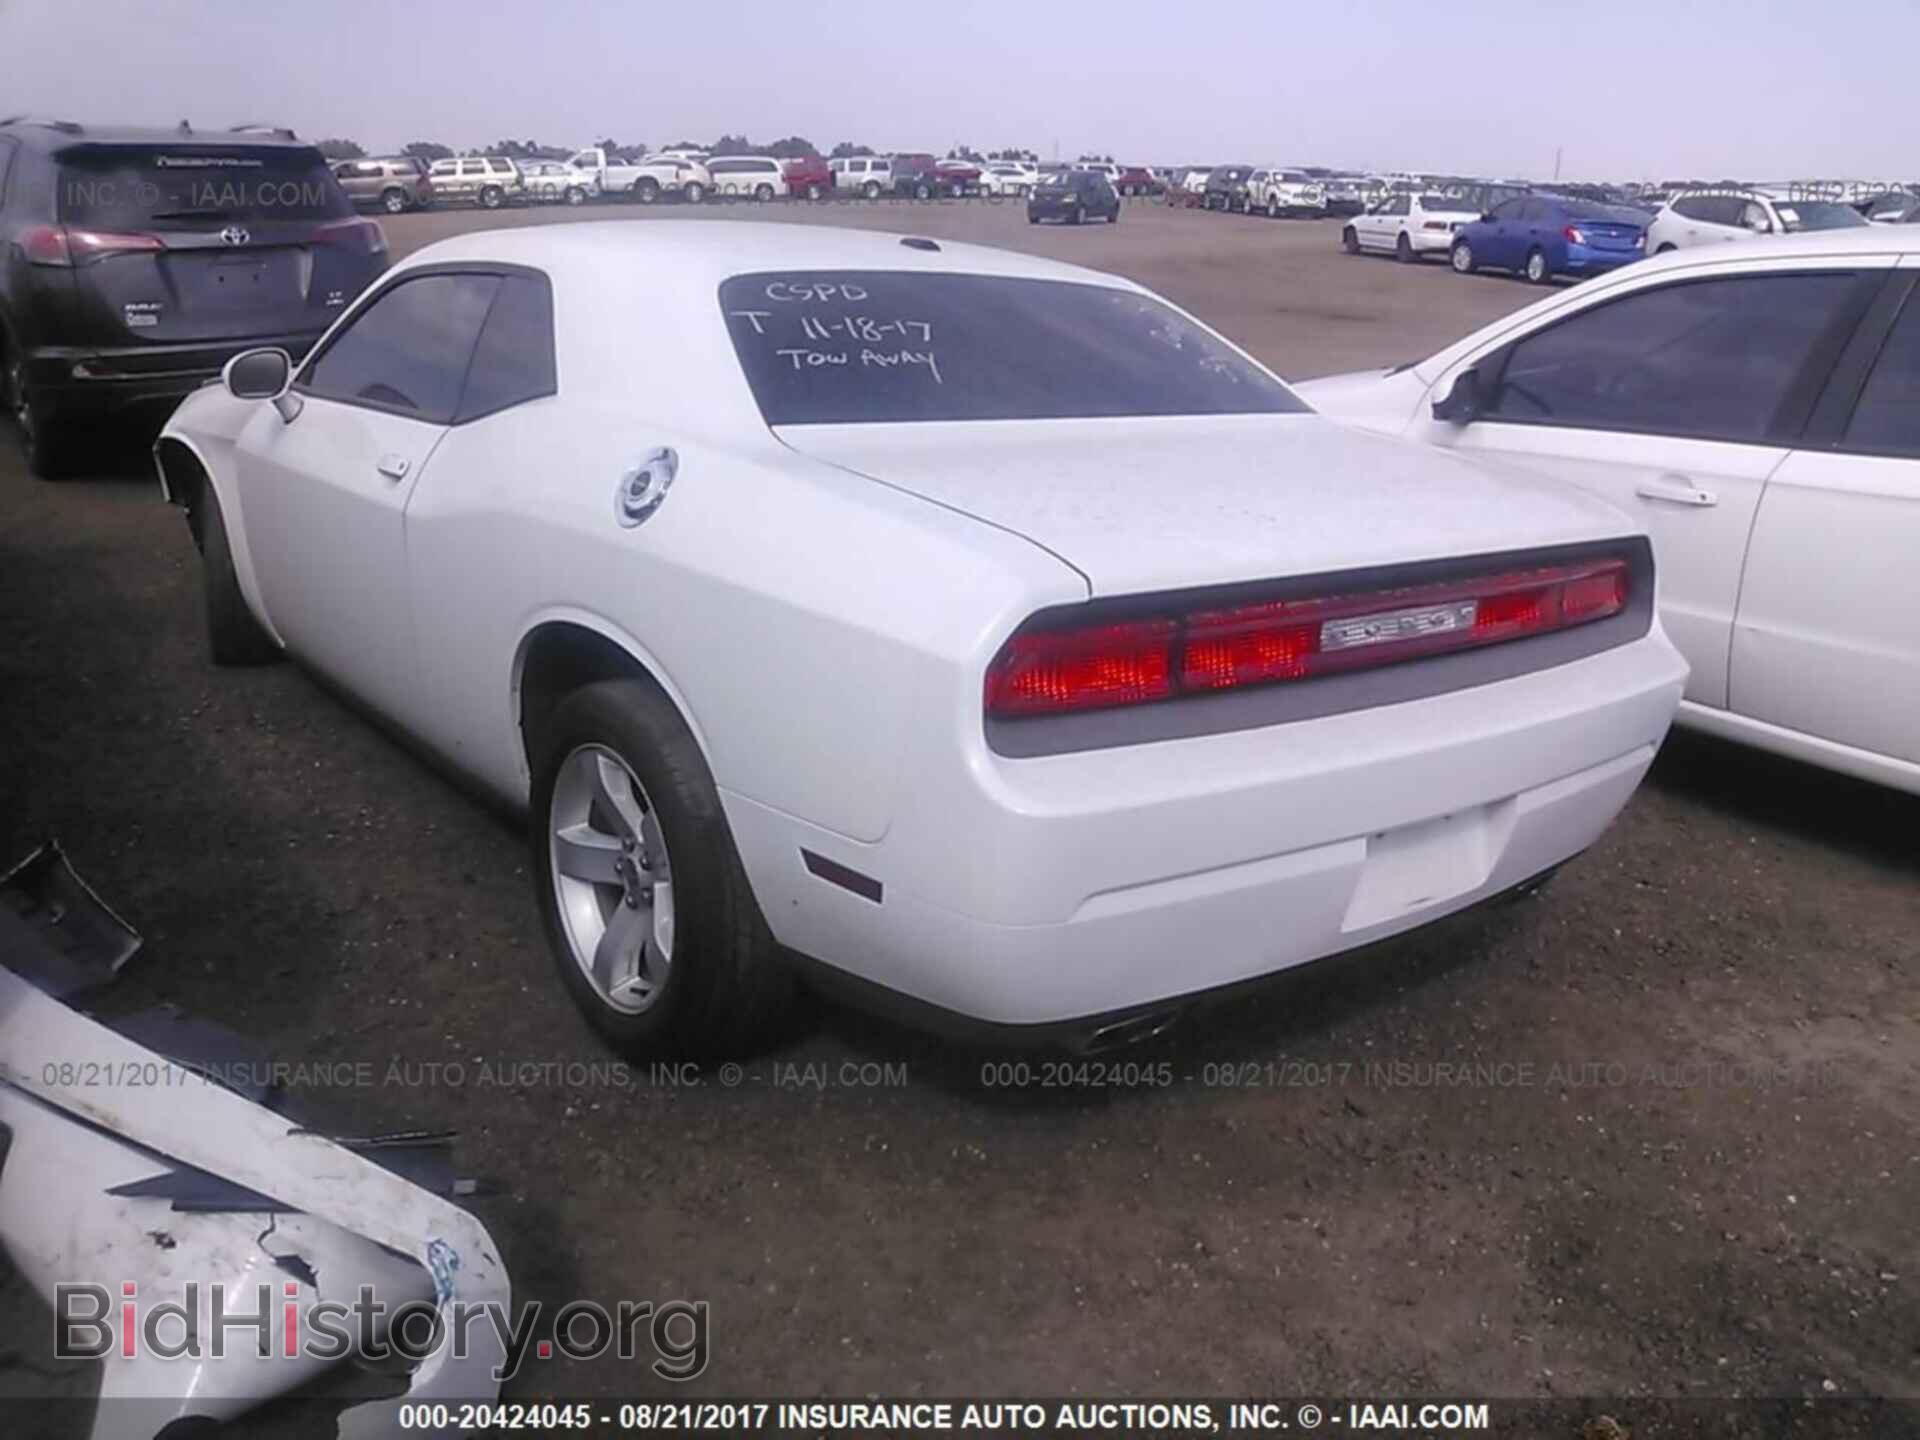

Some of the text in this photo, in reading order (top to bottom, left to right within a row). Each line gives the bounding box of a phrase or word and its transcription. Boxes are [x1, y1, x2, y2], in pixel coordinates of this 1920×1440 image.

[766, 282, 868, 301] CSPD
[730, 311, 930, 342] T 11-18-17
